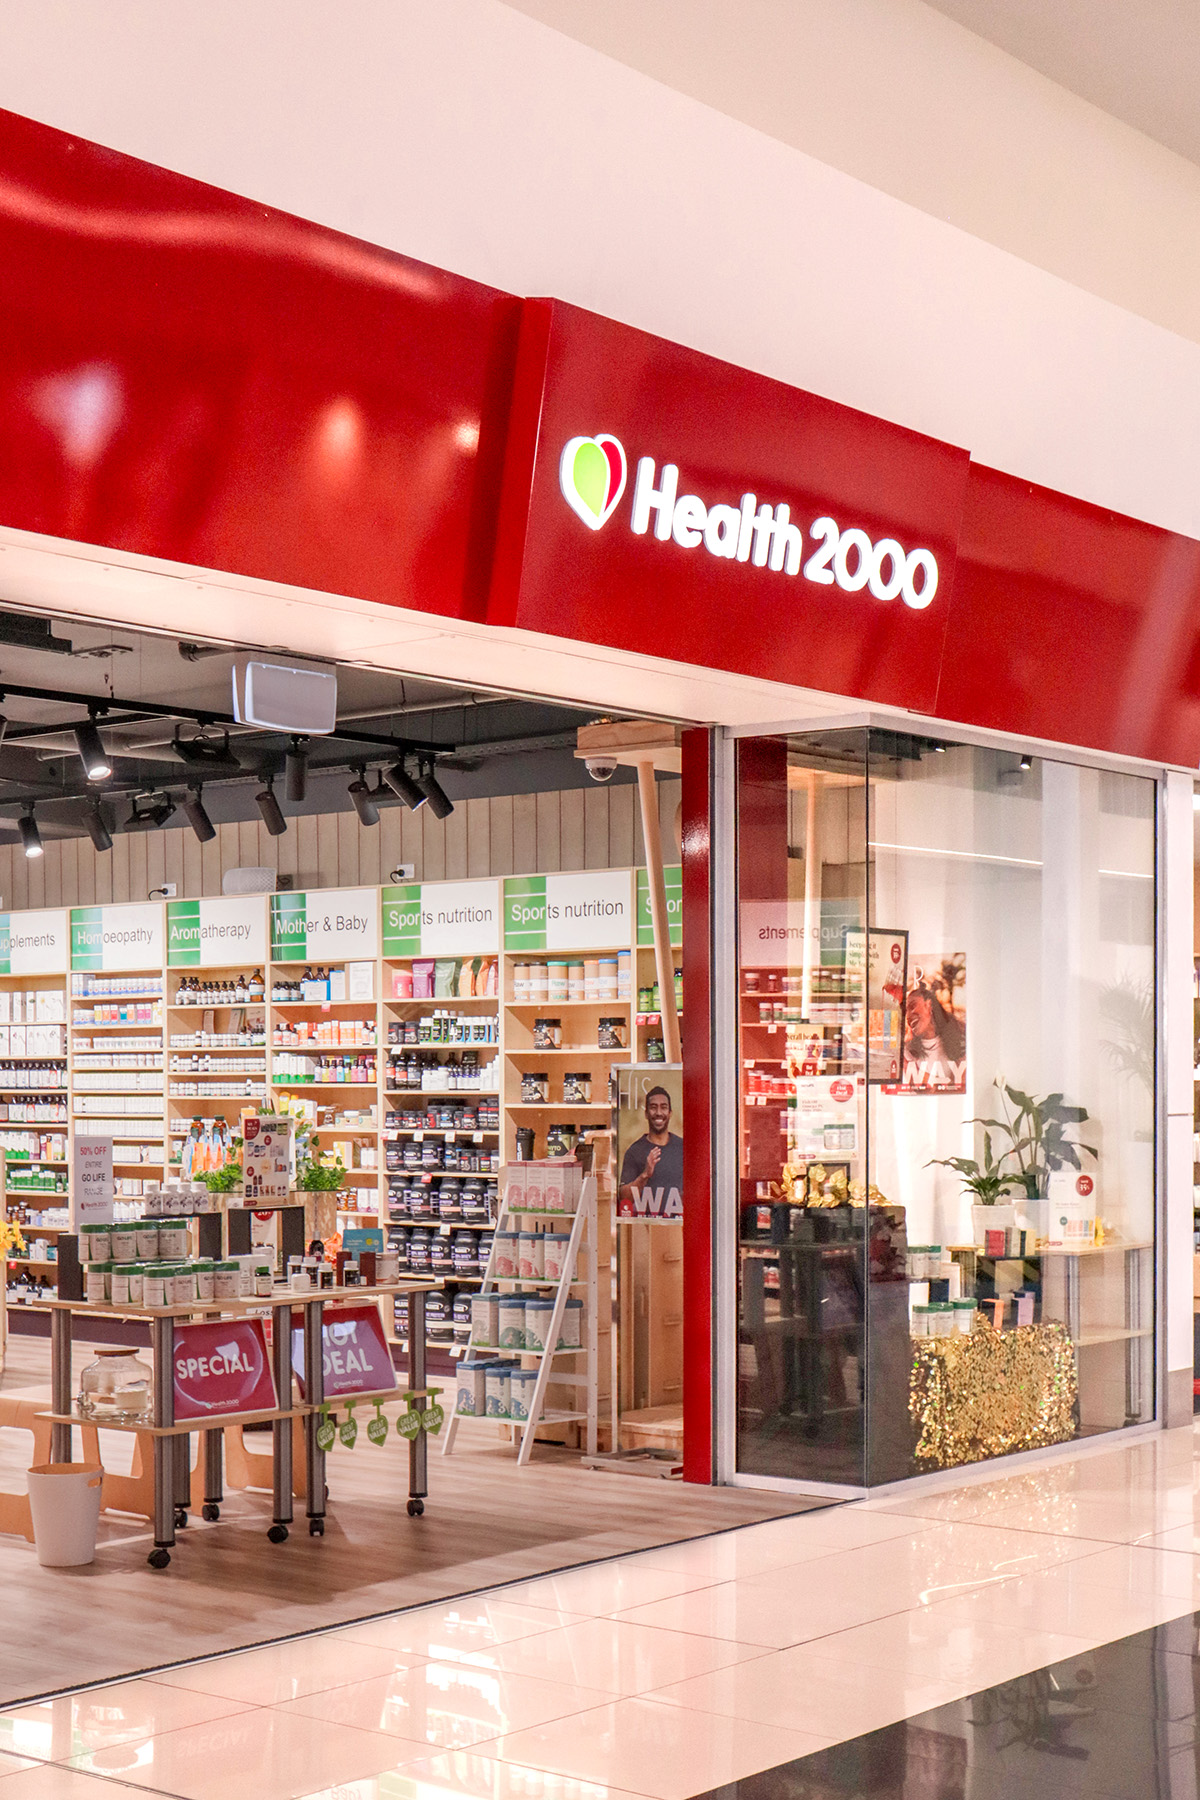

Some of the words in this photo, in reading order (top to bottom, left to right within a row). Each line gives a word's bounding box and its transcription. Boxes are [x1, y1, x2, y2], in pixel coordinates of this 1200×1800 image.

[630, 457, 802, 575] Health
[804, 517, 938, 609] 2000
[511, 903, 559, 925] Sports
[565, 900, 624, 918] nutrition
[646, 896, 682, 914] Sor
[276, 917, 319, 935] Mother
[323, 916, 332, 931] &
[336, 915, 368, 933] Baby
[389, 910, 433, 930] Sports
[438, 907, 492, 924] nutrition
[77, 927, 153, 946] Homoeopathy
[170, 923, 251, 941] Aromatherapy
[903, 1060, 966, 1086] WAY
[80, 1146, 93, 1156] 50%
[94, 1146, 107, 1156] OFF
[82, 1173, 91, 1182] GO
[93, 1172, 106, 1182] LIFE
[176, 1352, 254, 1380] SPECIAL
[323, 1348, 374, 1376] DEAL
